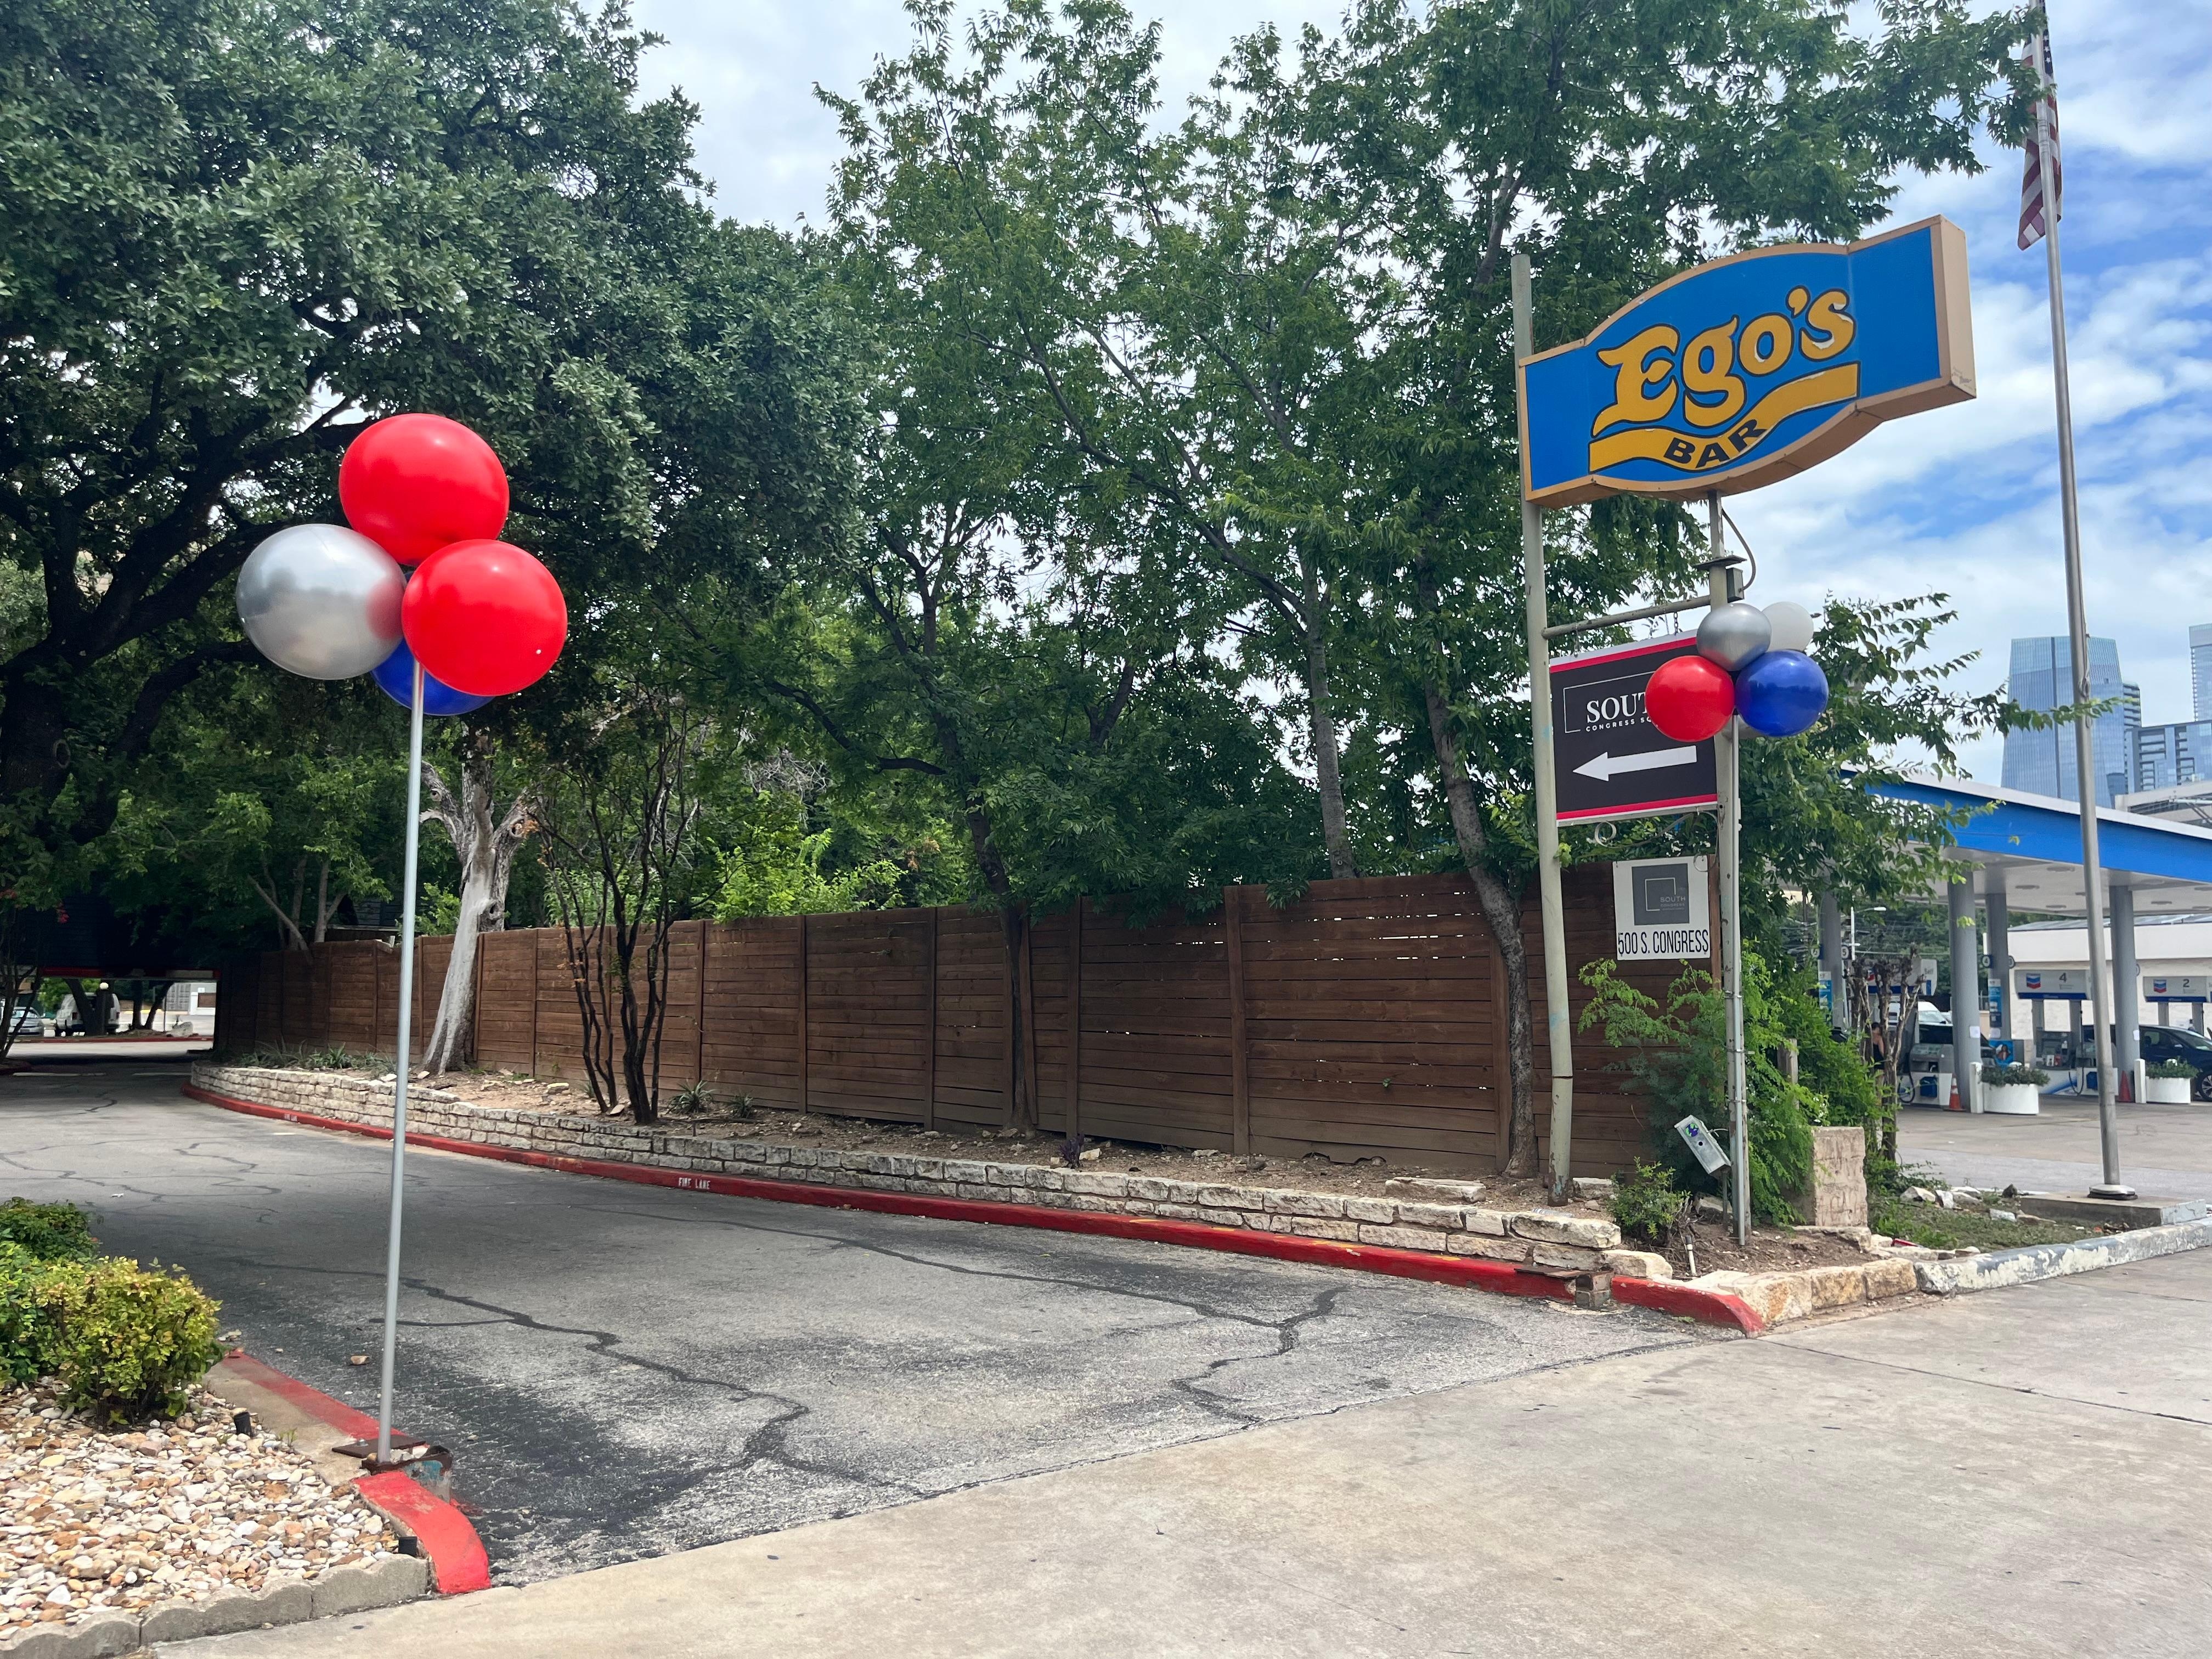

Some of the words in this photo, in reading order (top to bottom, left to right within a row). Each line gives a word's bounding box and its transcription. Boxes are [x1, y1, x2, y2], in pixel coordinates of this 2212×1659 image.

[1592, 285, 1857, 438] Ego's
[1663, 419, 1767, 469] BAR
[1587, 691, 1647, 723] SOUT
[1585, 719, 1635, 732] CONGRESS
[1618, 932, 1638, 954] 500
[1641, 932, 1650, 954] S.
[1653, 929, 1708, 953] CONGRESS
[2058, 972, 2067, 983] 4
[2183, 979, 2191, 988] 2
